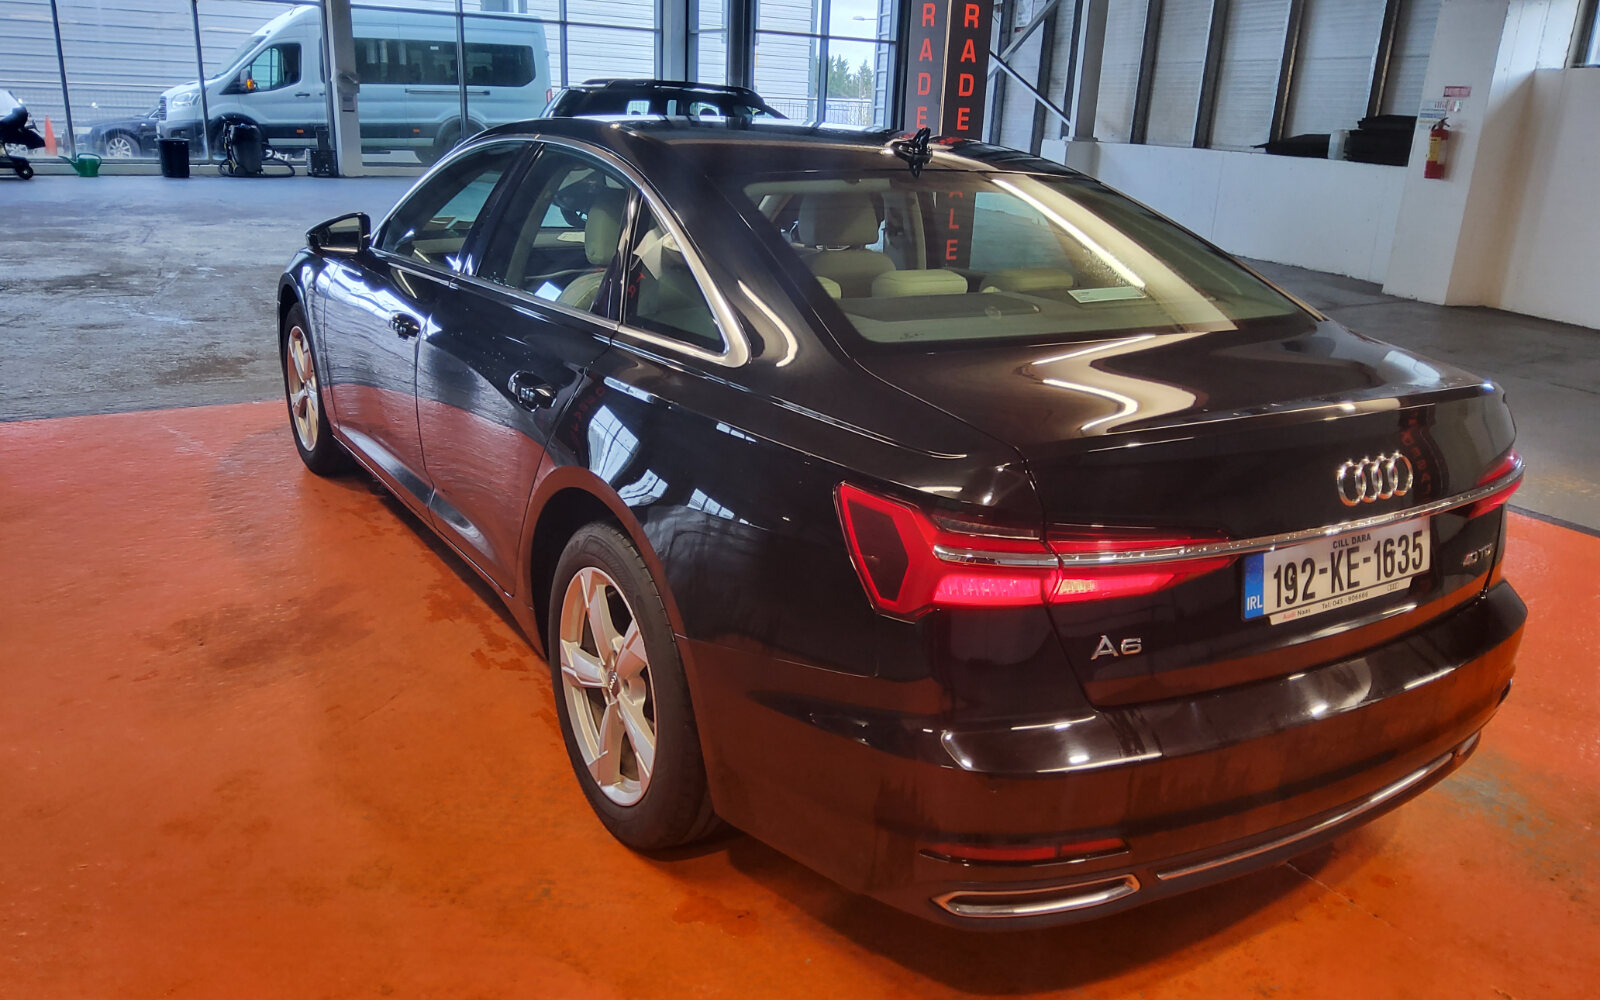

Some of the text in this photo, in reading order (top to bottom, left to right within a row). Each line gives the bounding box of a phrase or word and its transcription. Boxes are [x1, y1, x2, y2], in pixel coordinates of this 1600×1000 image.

[956, 3, 980, 131] RADE
[1332, 533, 1371, 549] CILL DARA
[1273, 530, 1423, 608] 192-KE-1635
[1247, 596, 1263, 611] IRL
[1090, 634, 1142, 660] A6
